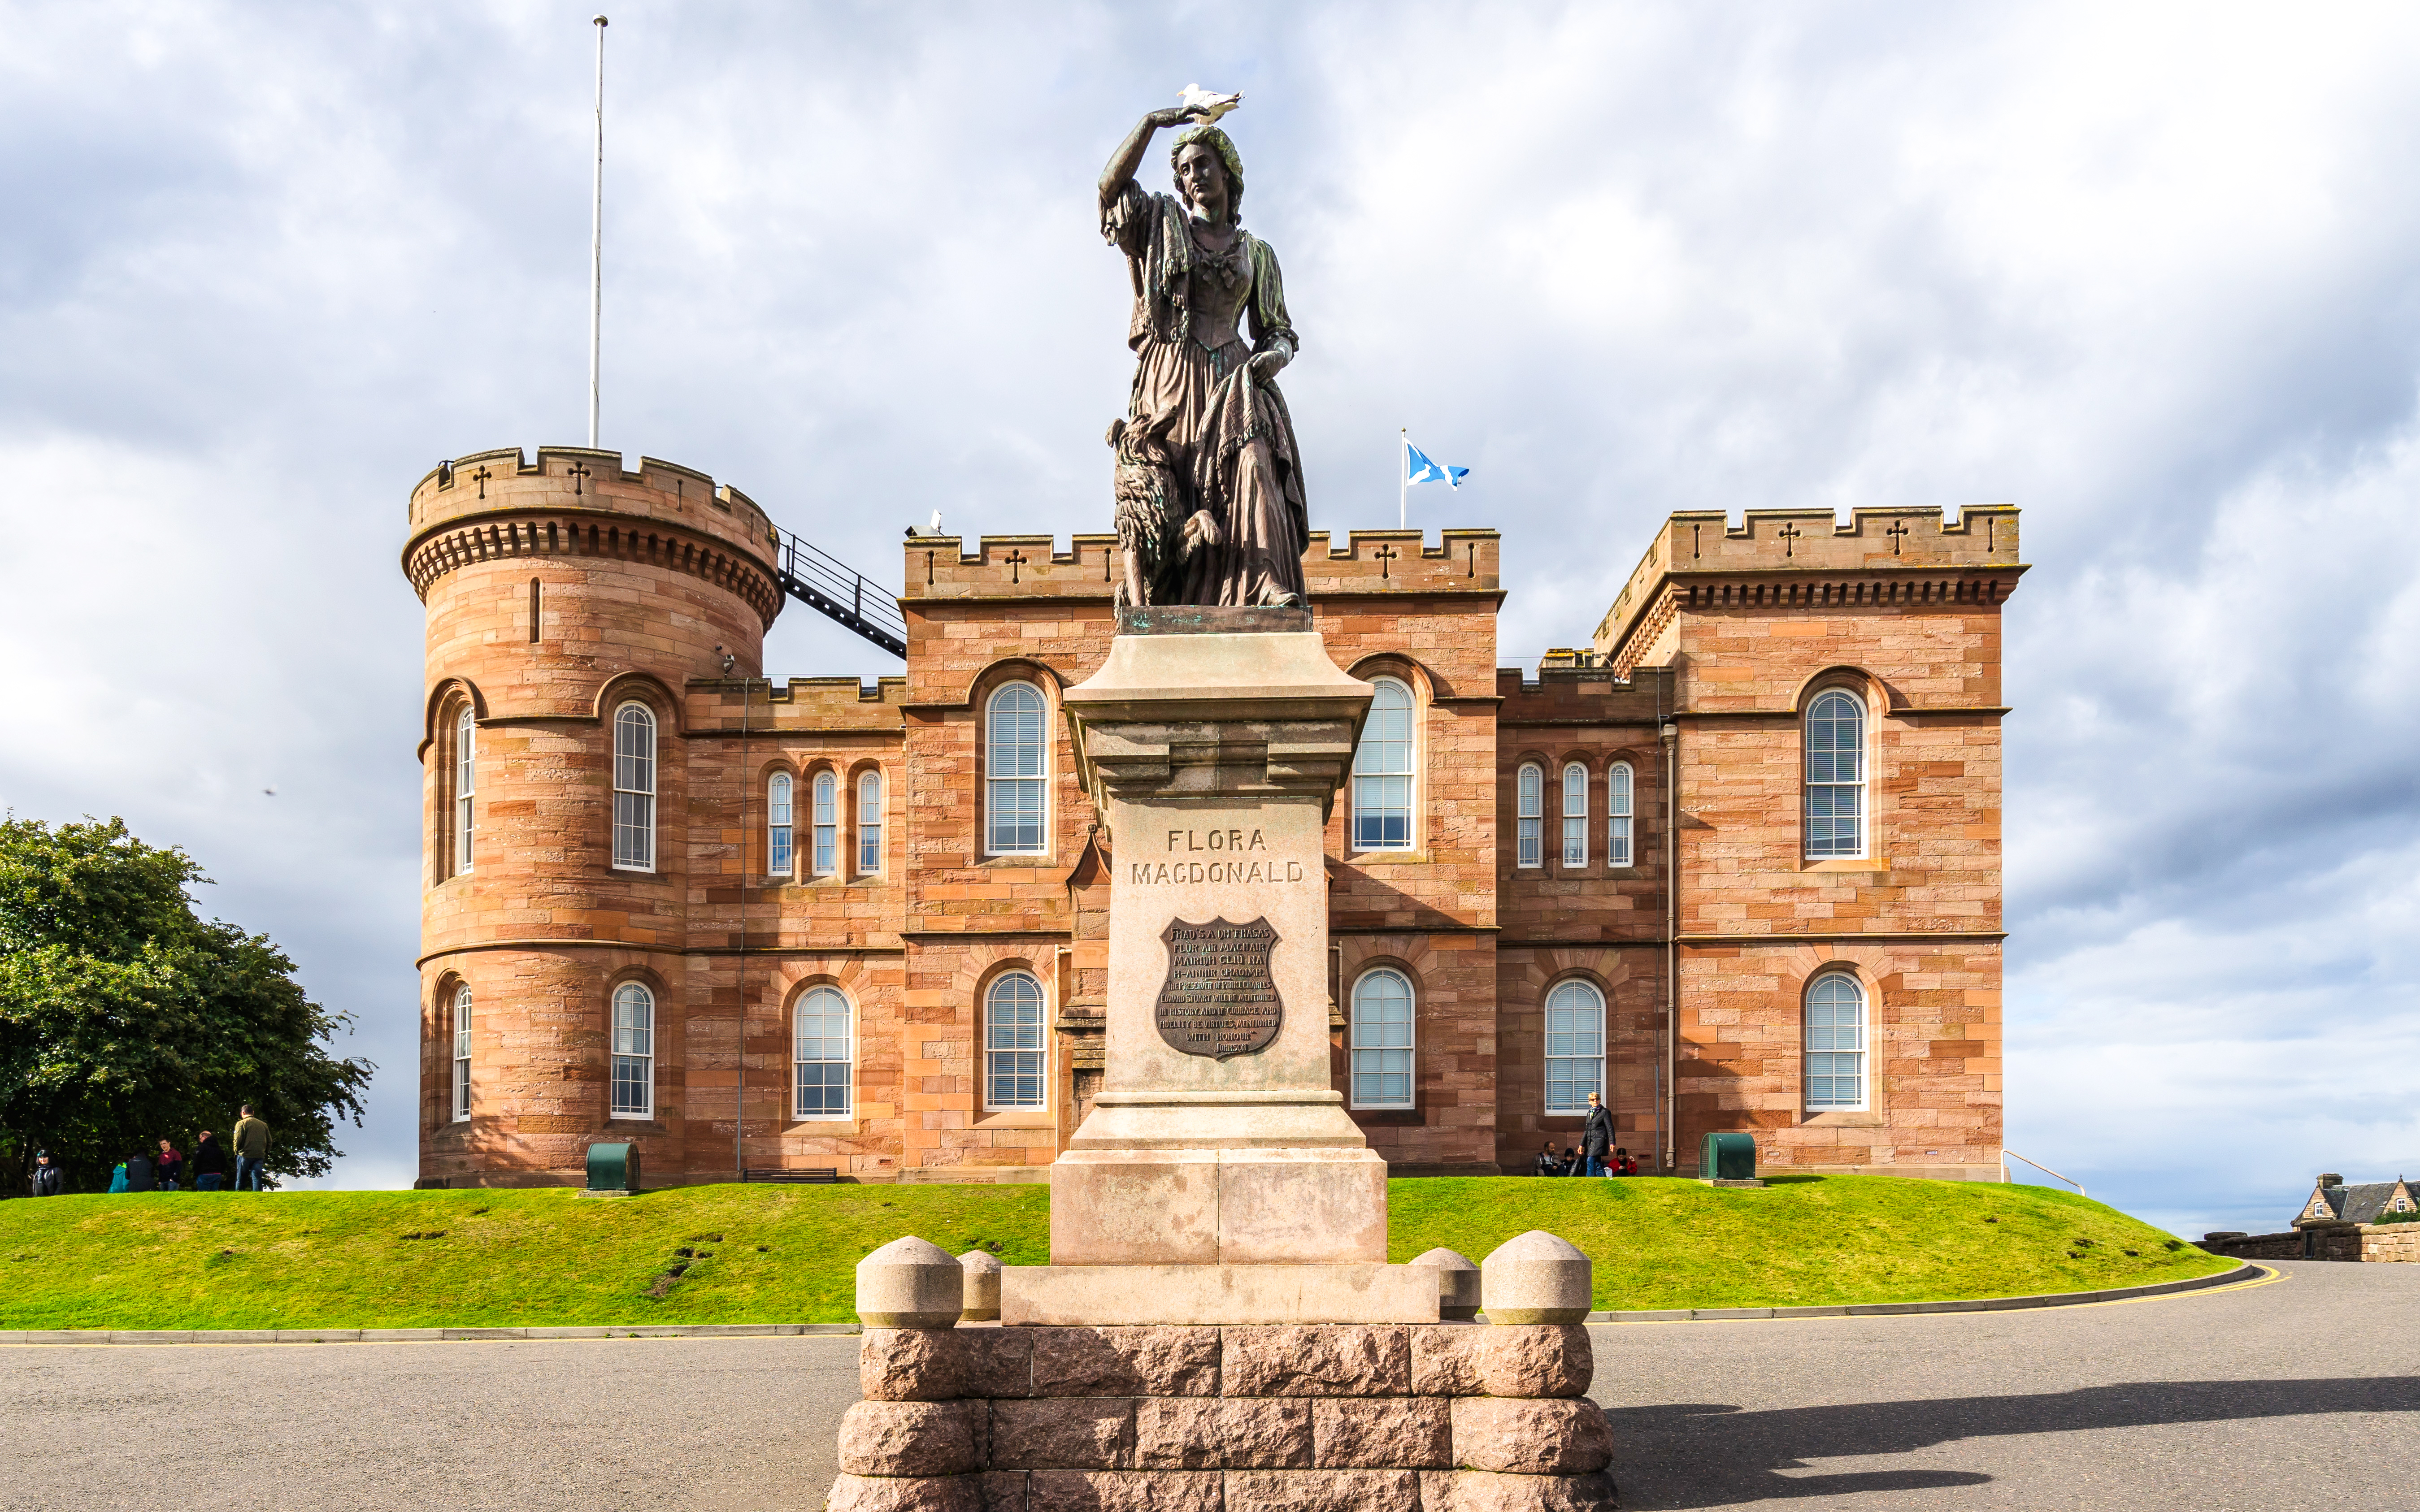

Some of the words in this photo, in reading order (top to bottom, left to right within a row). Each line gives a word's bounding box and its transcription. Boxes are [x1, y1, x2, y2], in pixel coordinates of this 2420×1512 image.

[1169, 829, 1268, 852] FLORA
[1132, 862, 1304, 885] MACDONALD
[1202, 943, 1217, 952] AIR
[1219, 942, 1265, 952] MACHAIR
[1174, 956, 1216, 966] MAIRIDH
[1248, 955, 1263, 964] NA
[1173, 969, 1217, 979] H-AINNIR
[1220, 968, 1264, 976] CHAOIMH.
[1178, 982, 1212, 990] PRESERVER
[1222, 980, 1242, 989] PRINCE
[1161, 994, 1184, 1003] EDWARD
[1185, 994, 1211, 1003] STUART
[1212, 994, 1228, 1002] WILL
[1238, 993, 1274, 1001] MENTIONED
[1200, 1007, 1216, 1015] AND
[1218, 1006, 1225, 1015] IF
[1261, 1006, 1276, 1014] AND
[1159, 1020, 1191, 1028] FIDELITY
[1193, 1020, 1202, 1028] BE
[1236, 1019, 1276, 1027] MENTIONED
[1186, 1032, 1209, 1041] WITH
[1214, 1043, 1247, 1053] JOHNSON
